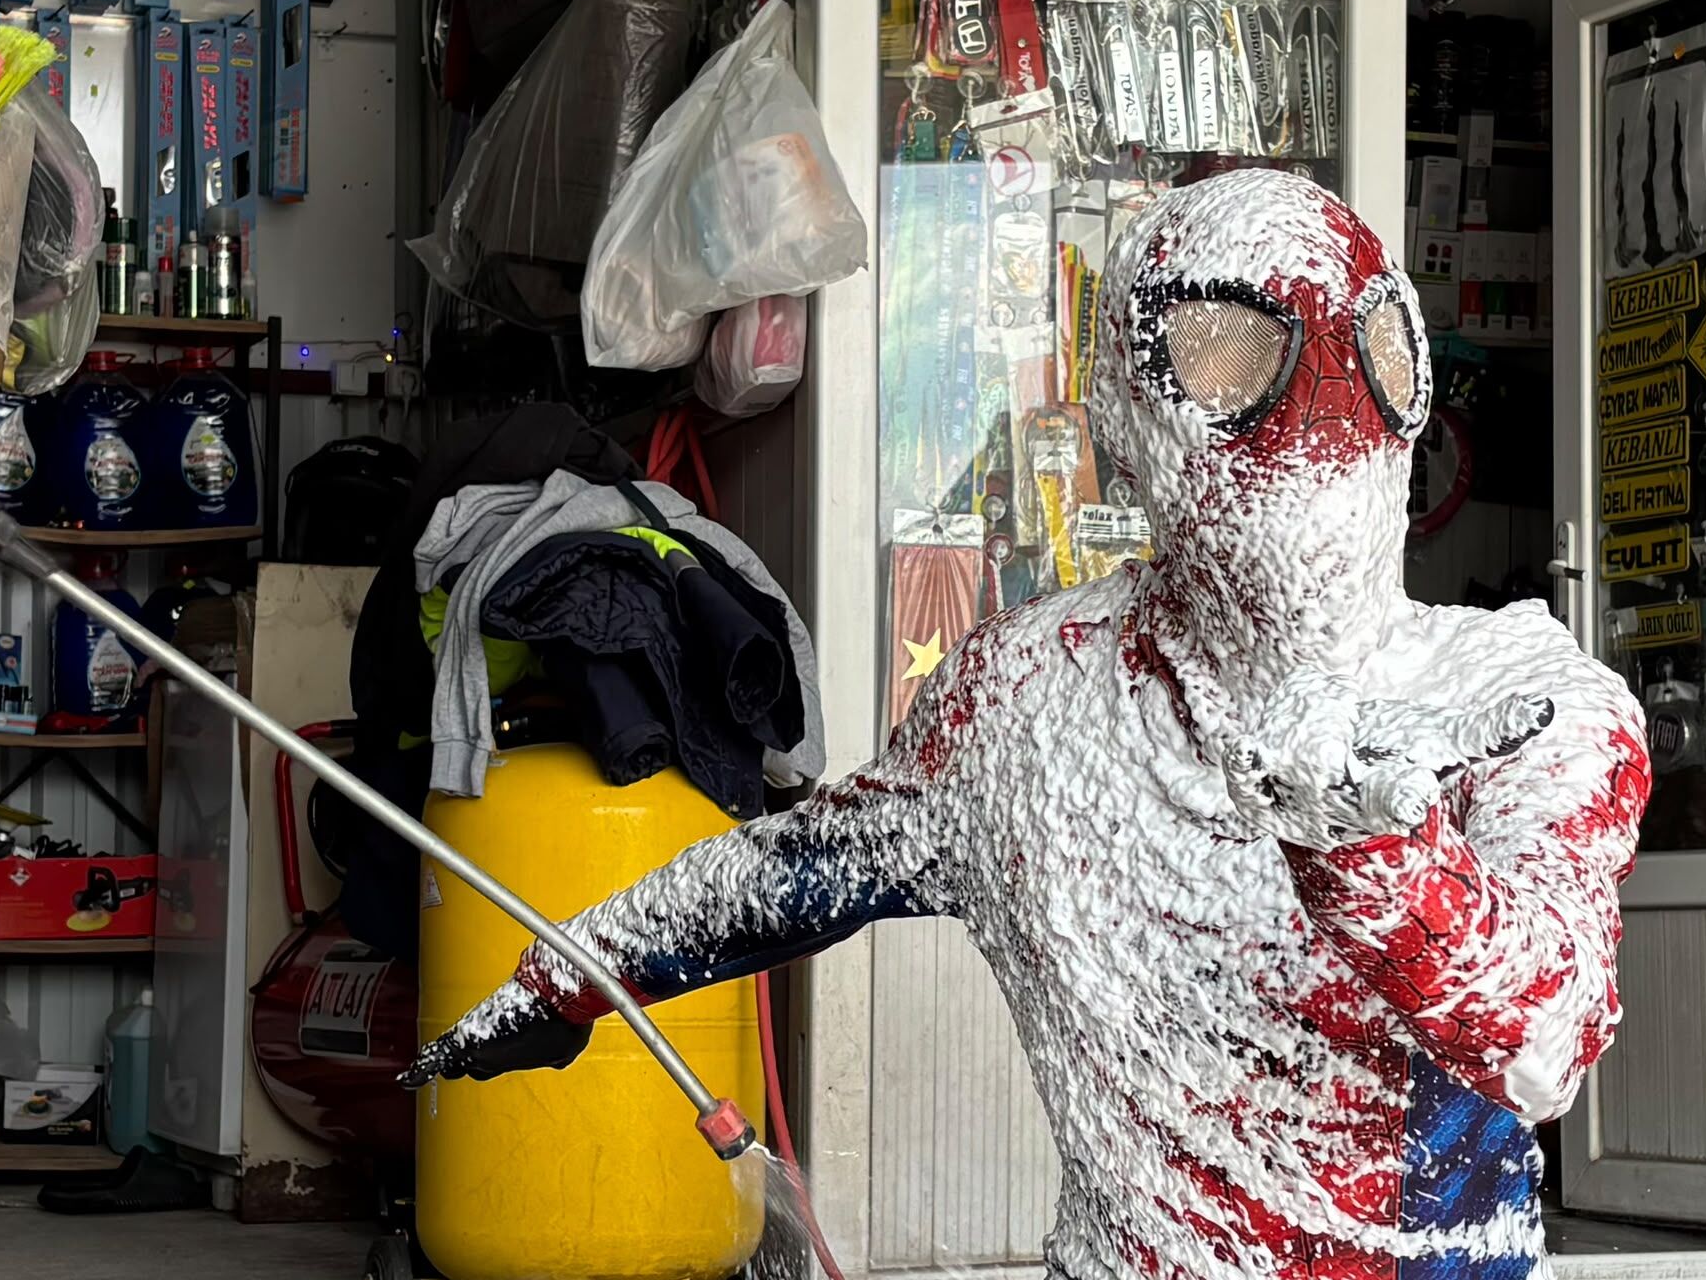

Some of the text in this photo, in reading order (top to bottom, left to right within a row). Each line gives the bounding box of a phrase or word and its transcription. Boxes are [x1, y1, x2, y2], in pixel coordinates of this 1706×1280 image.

[1244, 13, 1270, 103] Volkswagen
[1162, 57, 1180, 141] HONDA
[1613, 269, 1692, 319] KEBANLI
[1604, 426, 1685, 468] KEBANLI
[1606, 538, 1683, 571] EVLAT
